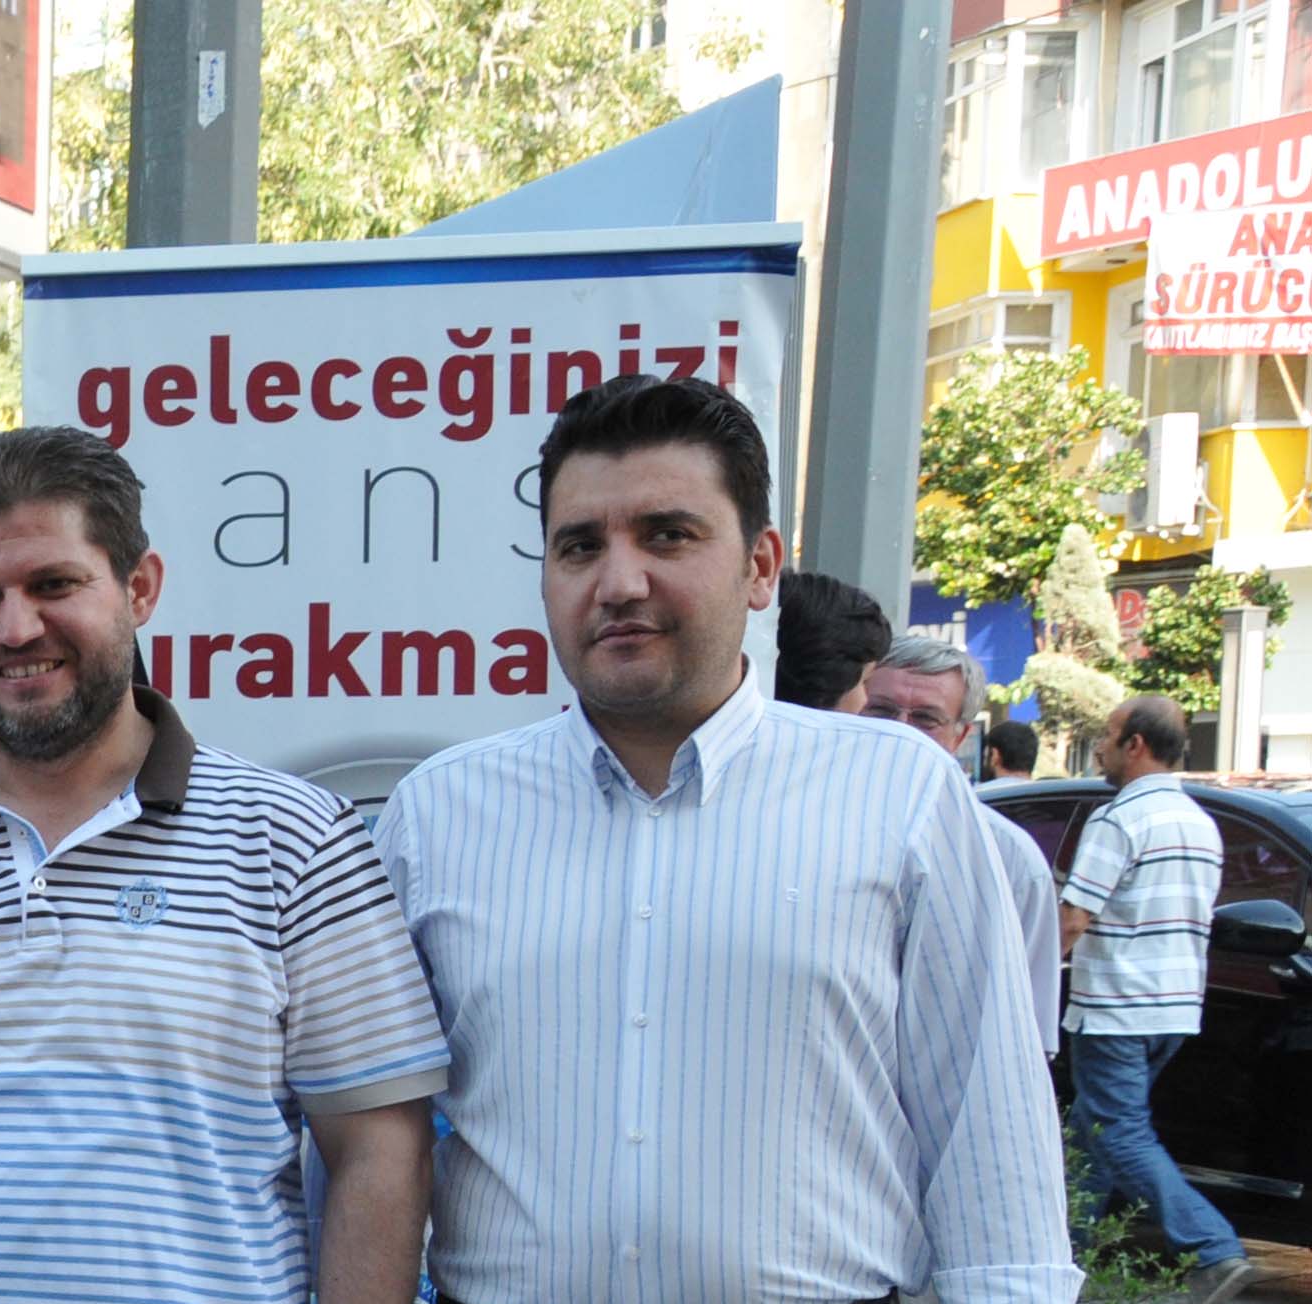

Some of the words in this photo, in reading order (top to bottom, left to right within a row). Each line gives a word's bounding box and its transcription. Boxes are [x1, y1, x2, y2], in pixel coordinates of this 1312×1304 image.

[1056, 134, 1312, 244] ANADOLU
[1150, 259, 1312, 316] SÜRÜC
[77, 320, 739, 447] geleceğinizi
[151, 602, 570, 711] ırakma
